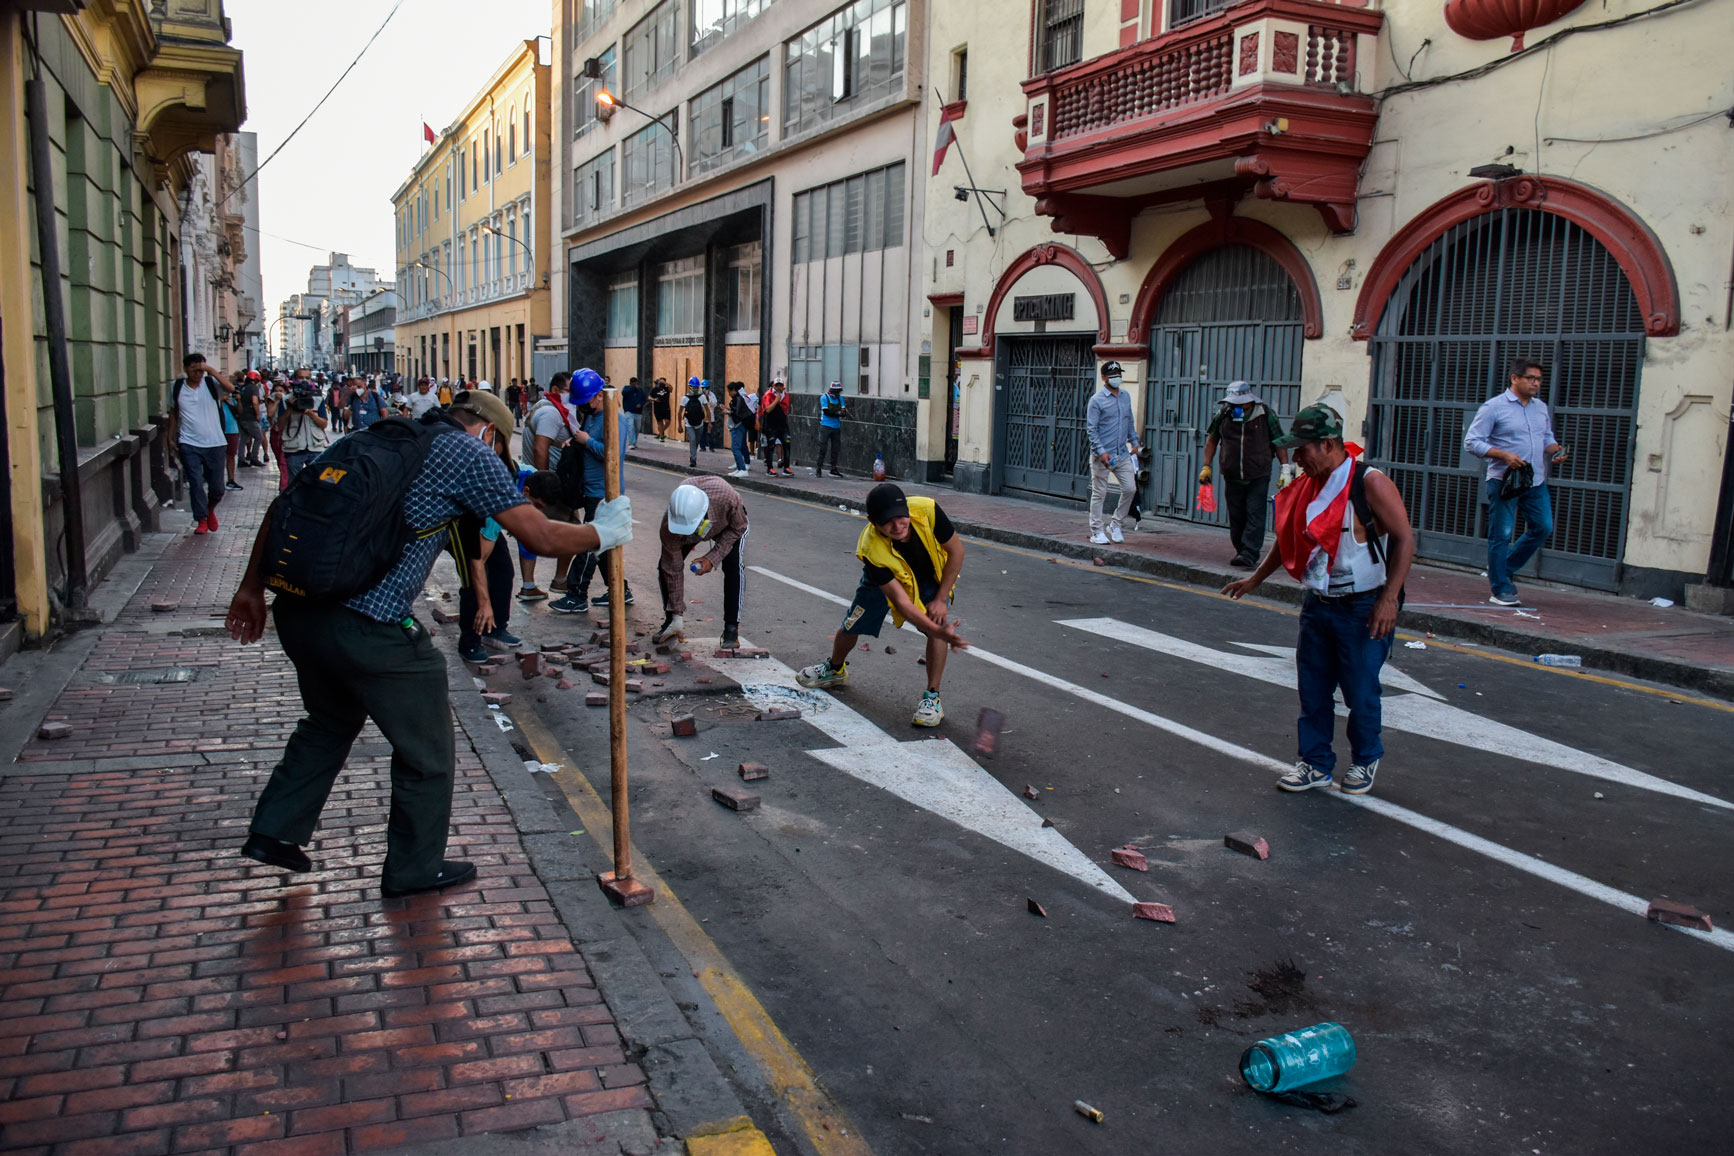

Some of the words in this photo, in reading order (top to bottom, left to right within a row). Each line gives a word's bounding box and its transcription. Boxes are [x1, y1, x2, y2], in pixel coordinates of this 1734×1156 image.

[1043, 293, 1074, 319] KING
[320, 467, 348, 484] CAT
[266, 577, 306, 597] ERPILLAR
